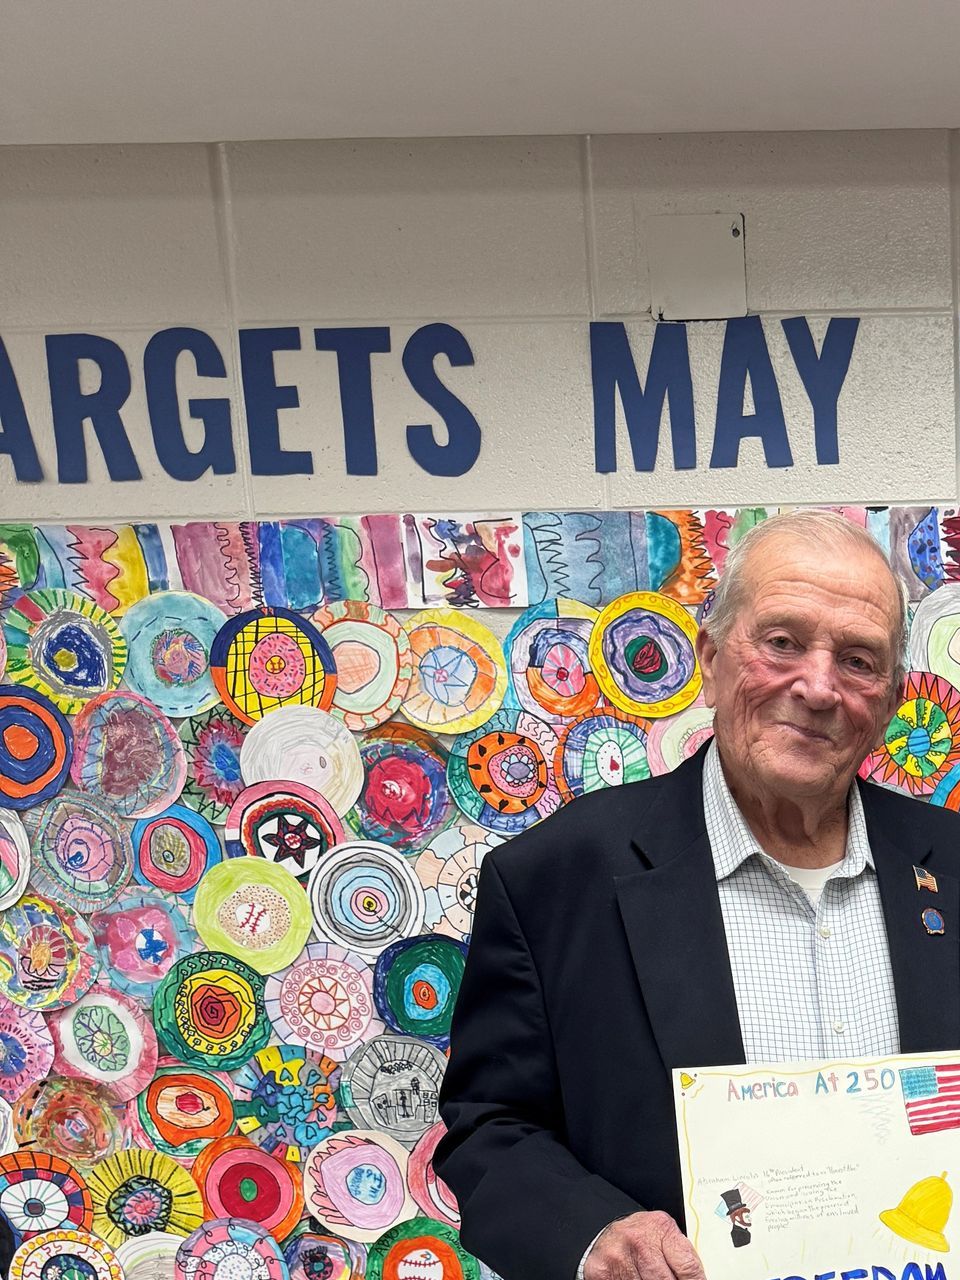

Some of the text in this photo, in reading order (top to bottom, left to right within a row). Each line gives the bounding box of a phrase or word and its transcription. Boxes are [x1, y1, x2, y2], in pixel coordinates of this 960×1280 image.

[589, 316, 860, 473] MAY
[727, 1068, 896, 1102] America At 250
[775, 1165, 804, 1176] President
